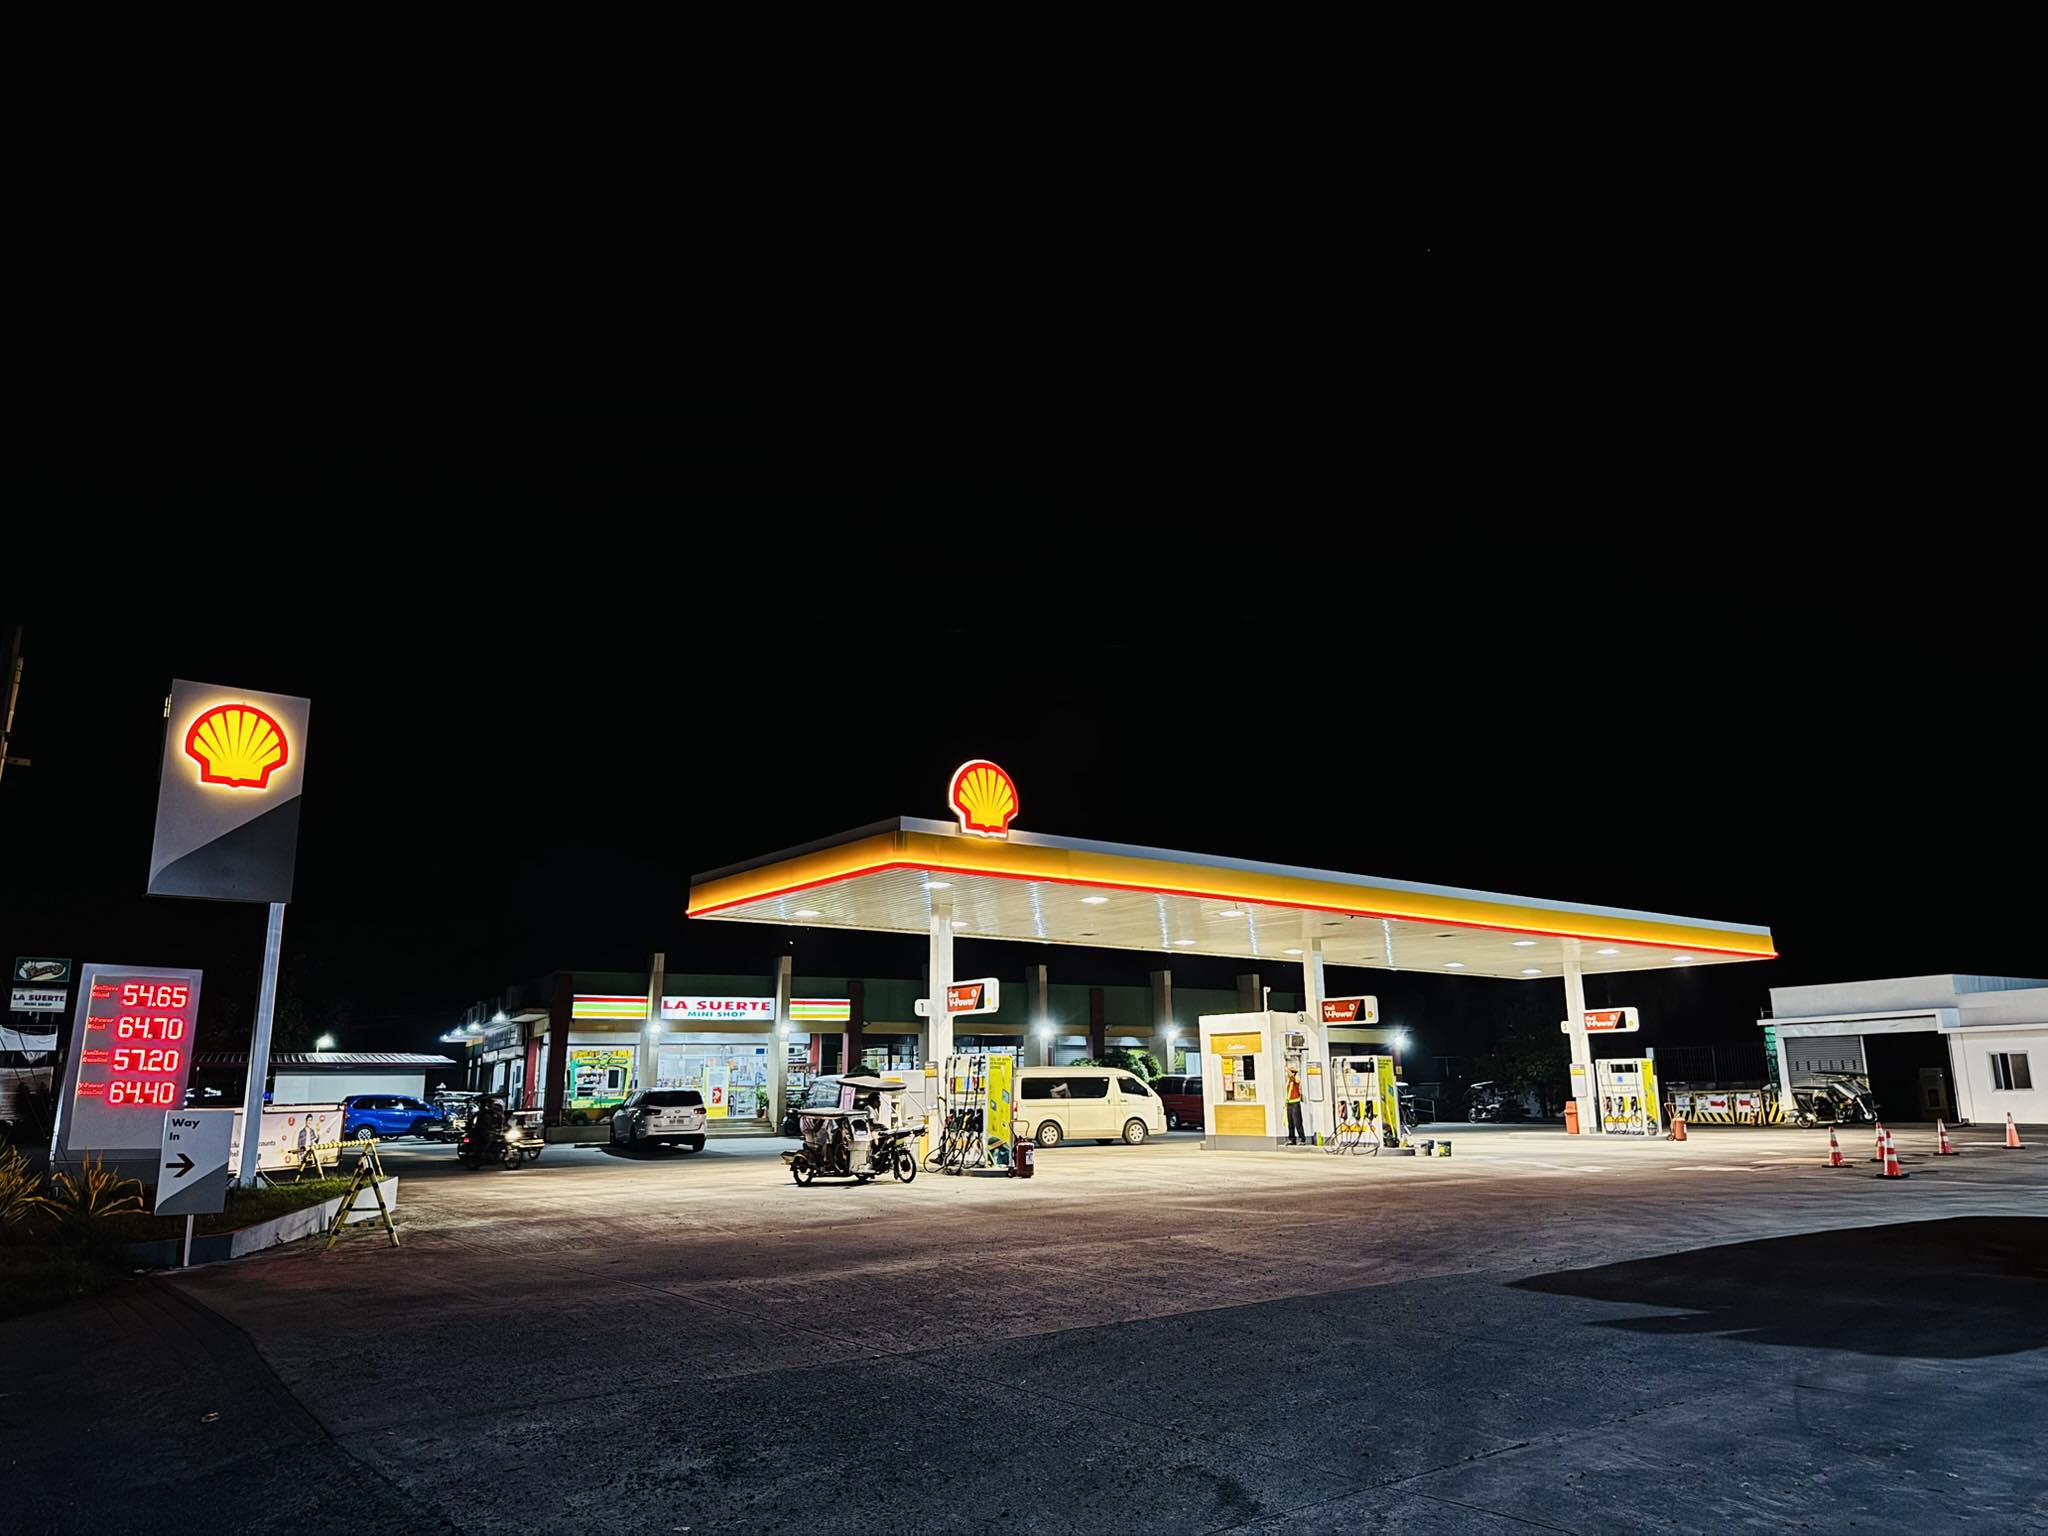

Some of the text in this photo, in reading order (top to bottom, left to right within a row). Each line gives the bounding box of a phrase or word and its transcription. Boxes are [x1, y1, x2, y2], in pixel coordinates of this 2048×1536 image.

[122, 985, 188, 1008] 54.65
[663, 1000, 771, 1011] LA SUERTE
[920, 1002, 925, 1013] 1
[1325, 1010, 1353, 1018] V-Power
[117, 1016, 184, 1040] 64.70
[113, 1048, 180, 1072] 57.20
[109, 1081, 176, 1104] 64.40
[171, 1118, 200, 1129] Way
[169, 1131, 180, 1141] In
